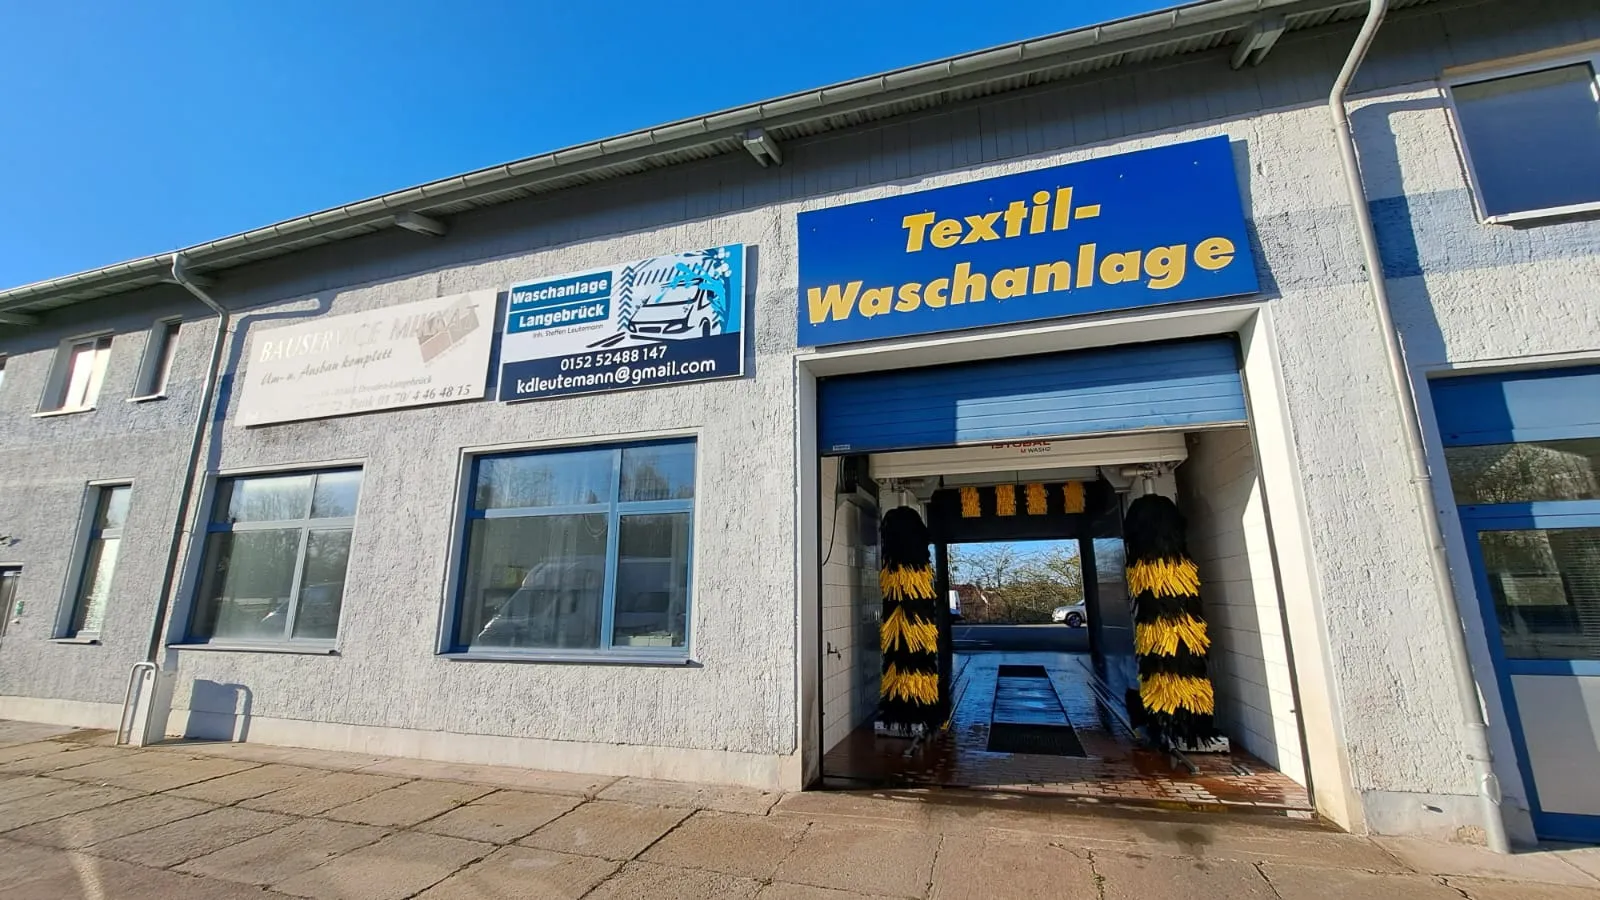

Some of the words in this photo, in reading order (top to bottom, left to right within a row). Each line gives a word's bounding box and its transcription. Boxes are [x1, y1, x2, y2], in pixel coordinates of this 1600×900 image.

[902, 186, 1101, 253] Textil-
[512, 278, 608, 306] Waschanlage
[807, 237, 1236, 324] Waschanlage
[519, 304, 605, 329] Langebrück
[259, 320, 383, 363] BAUSERVICE
[545, 328, 566, 337] Steffen
[567, 323, 604, 334] Leutemann
[341, 348, 393, 369] komplett
[560, 356, 592, 371] 0152
[595, 350, 639, 366] 52488
[643, 346, 667, 361] 147
[516, 358, 716, 394] kdleutemann@gmail.com
[422, 388, 436, 400] 46
[439, 385, 453, 398] 48
